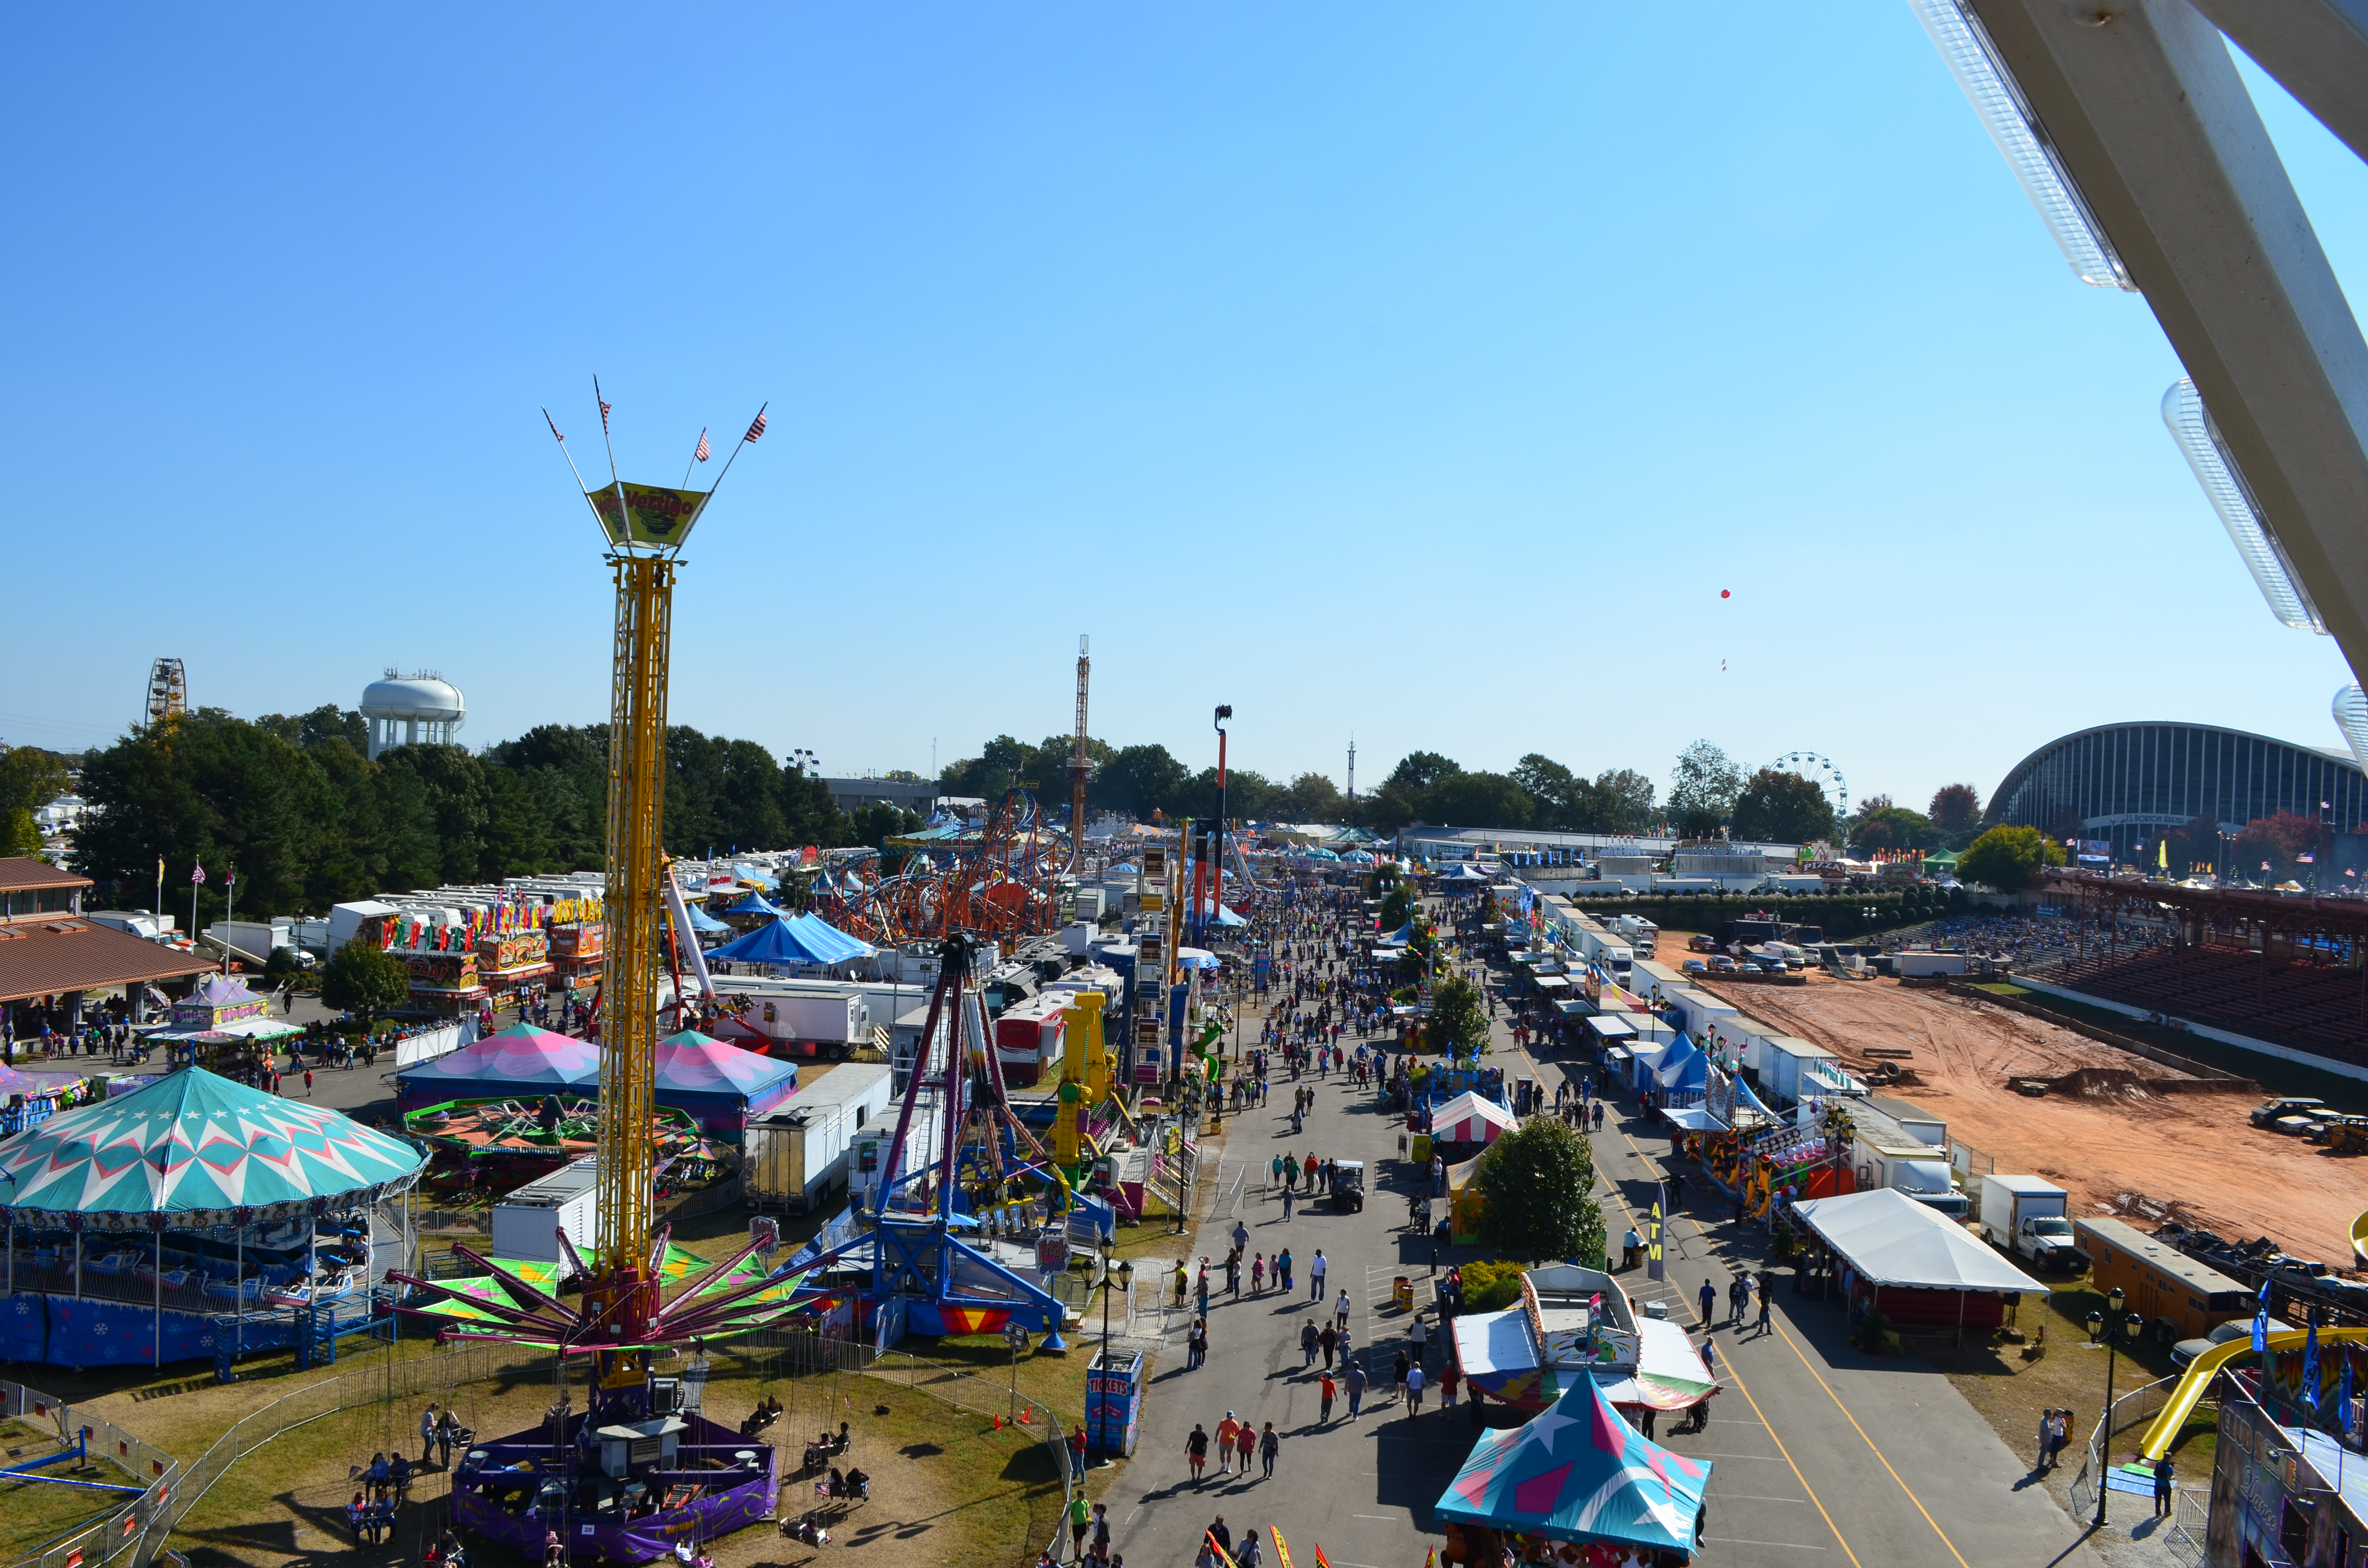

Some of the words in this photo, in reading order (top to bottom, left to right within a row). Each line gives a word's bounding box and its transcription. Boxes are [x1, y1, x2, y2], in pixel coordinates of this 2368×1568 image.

[626, 490, 693, 517] Vertigo
[2164, 815, 2183, 823] ARENA
[585, 925, 600, 934] FRENCH
[481, 944, 496, 953] DOGS
[407, 961, 448, 984] ZZA!
[1649, 1202, 1662, 1261] ATM
[1089, 1378, 1127, 1395] TICKETS
[2221, 1405, 2252, 1455] CLUB
[2241, 1466, 2276, 1531] Dance
